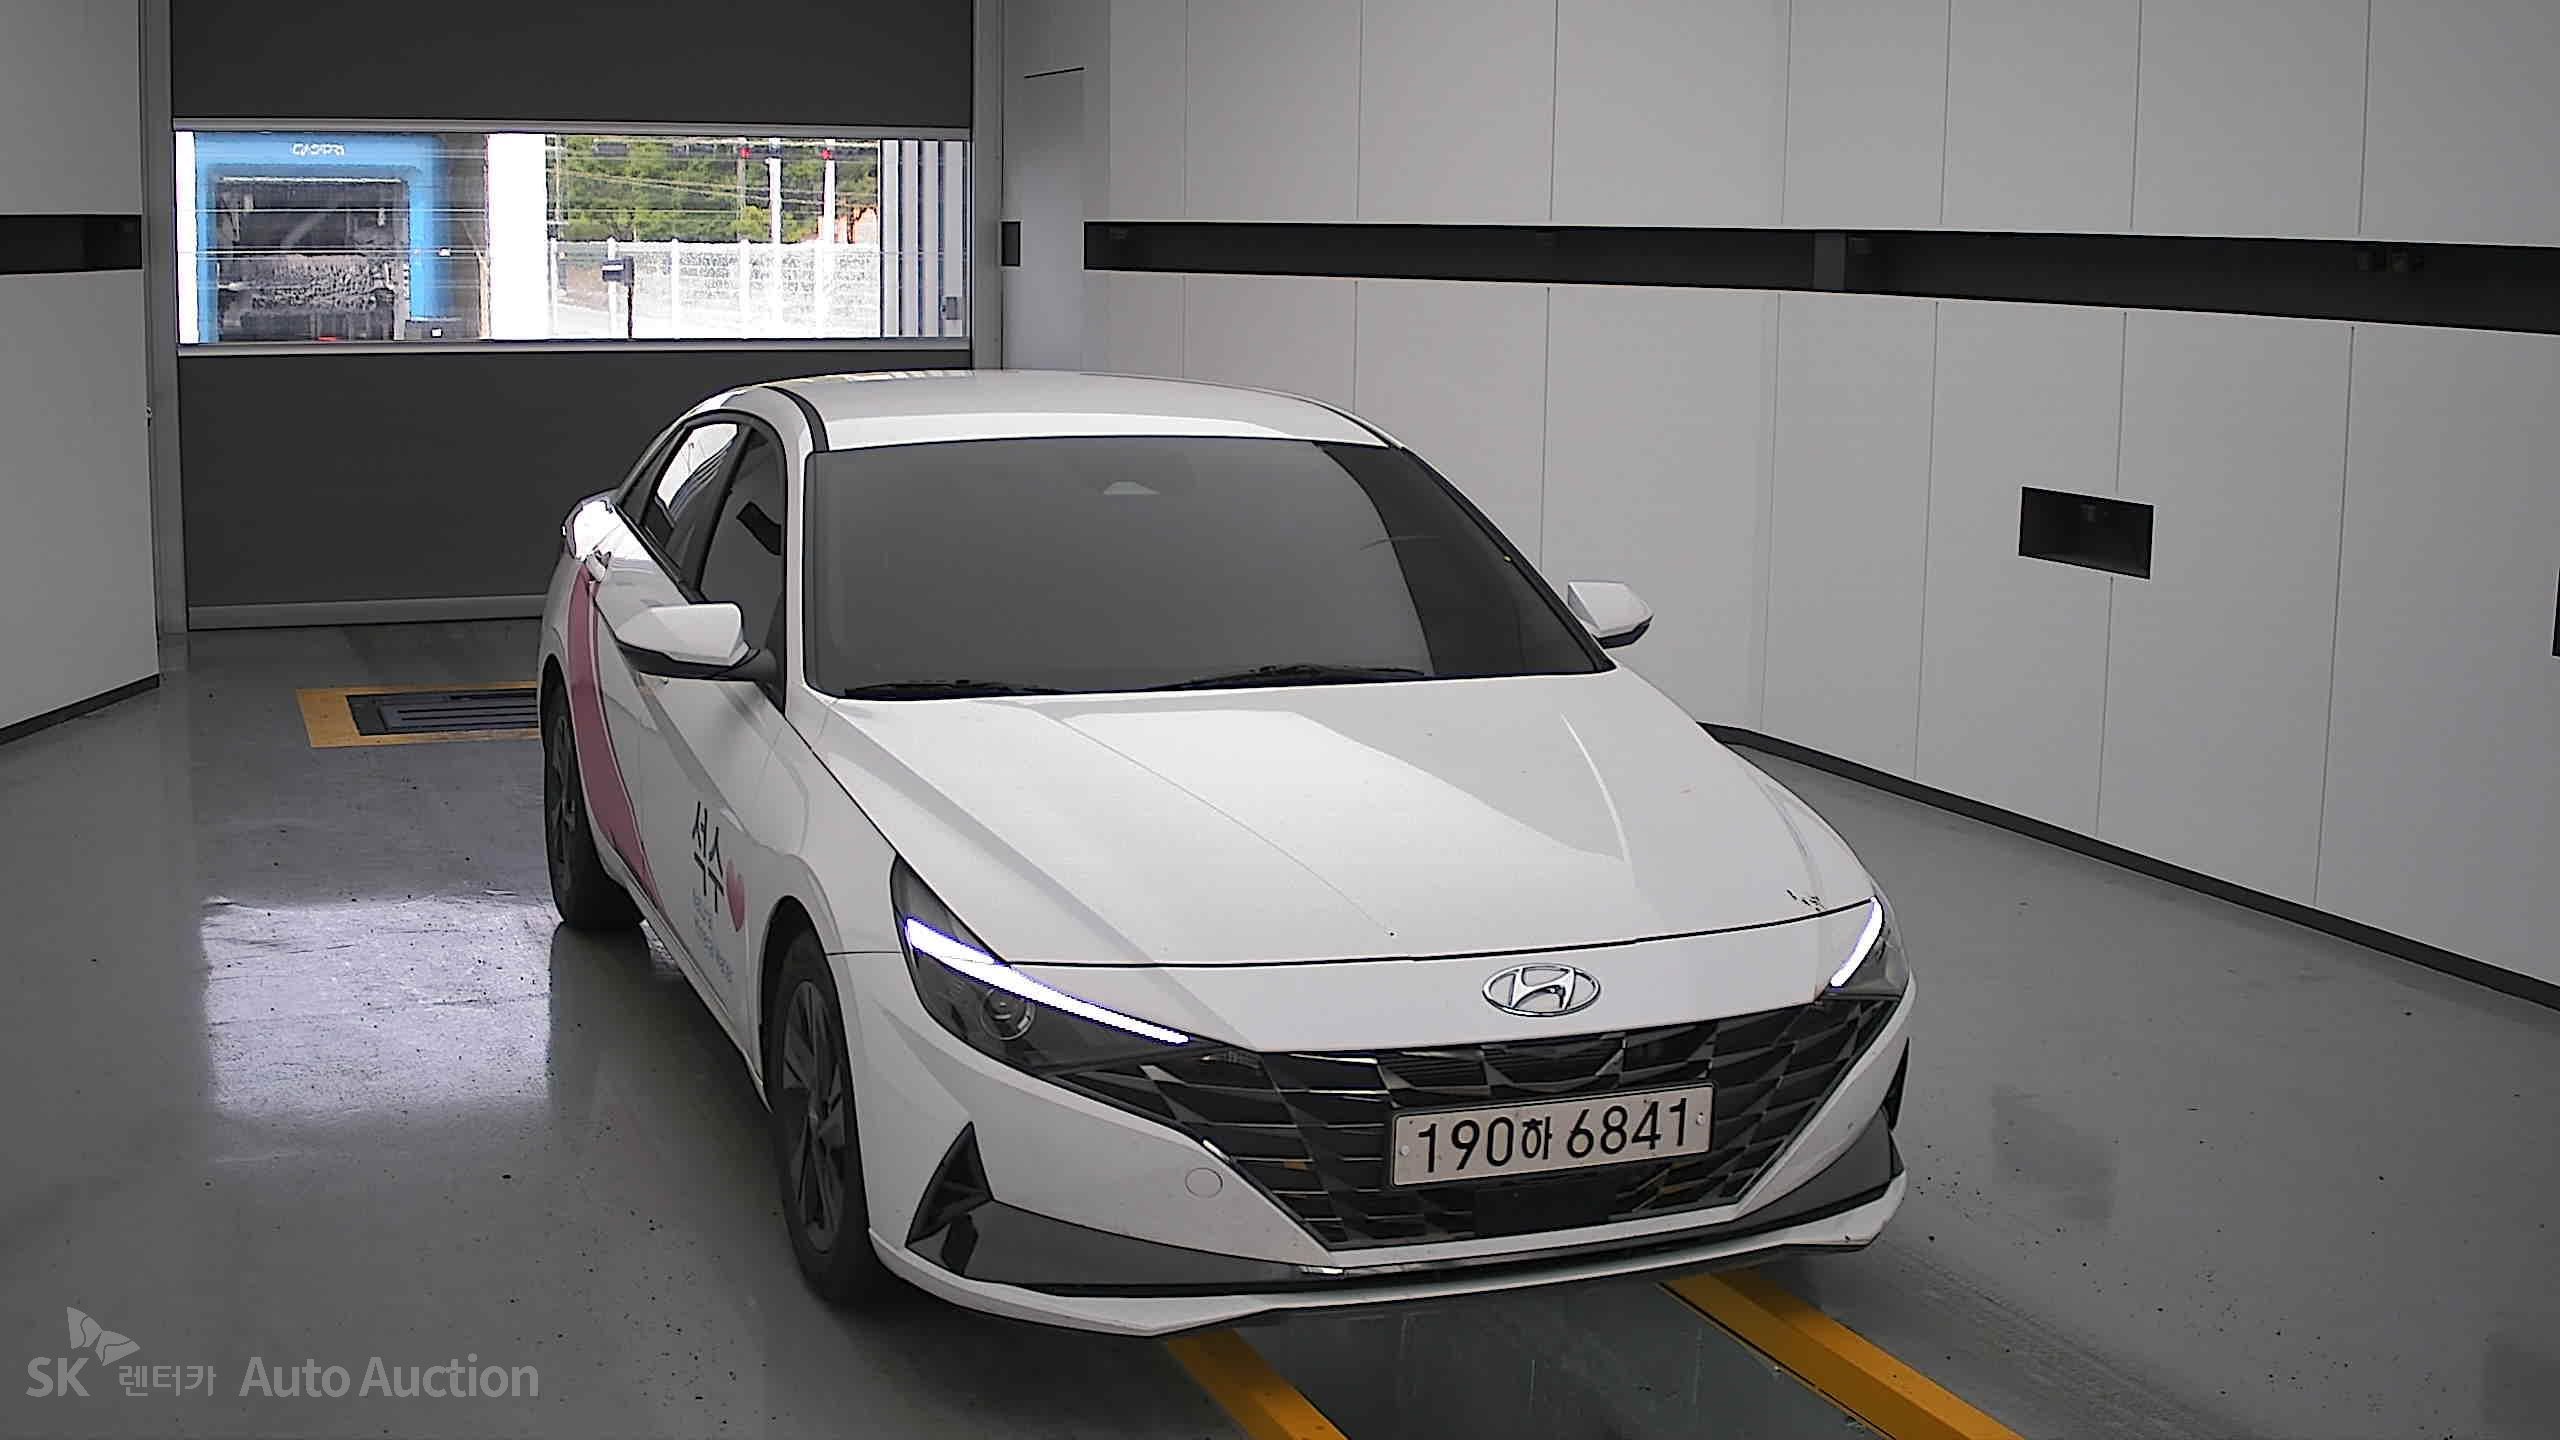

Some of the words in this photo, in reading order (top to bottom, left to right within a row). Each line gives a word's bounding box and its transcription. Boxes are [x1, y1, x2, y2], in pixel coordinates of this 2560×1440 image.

[692, 801, 725, 914] 석수
[1418, 1116, 1552, 1173] 190하
[1566, 1097, 1688, 1158] 6841
